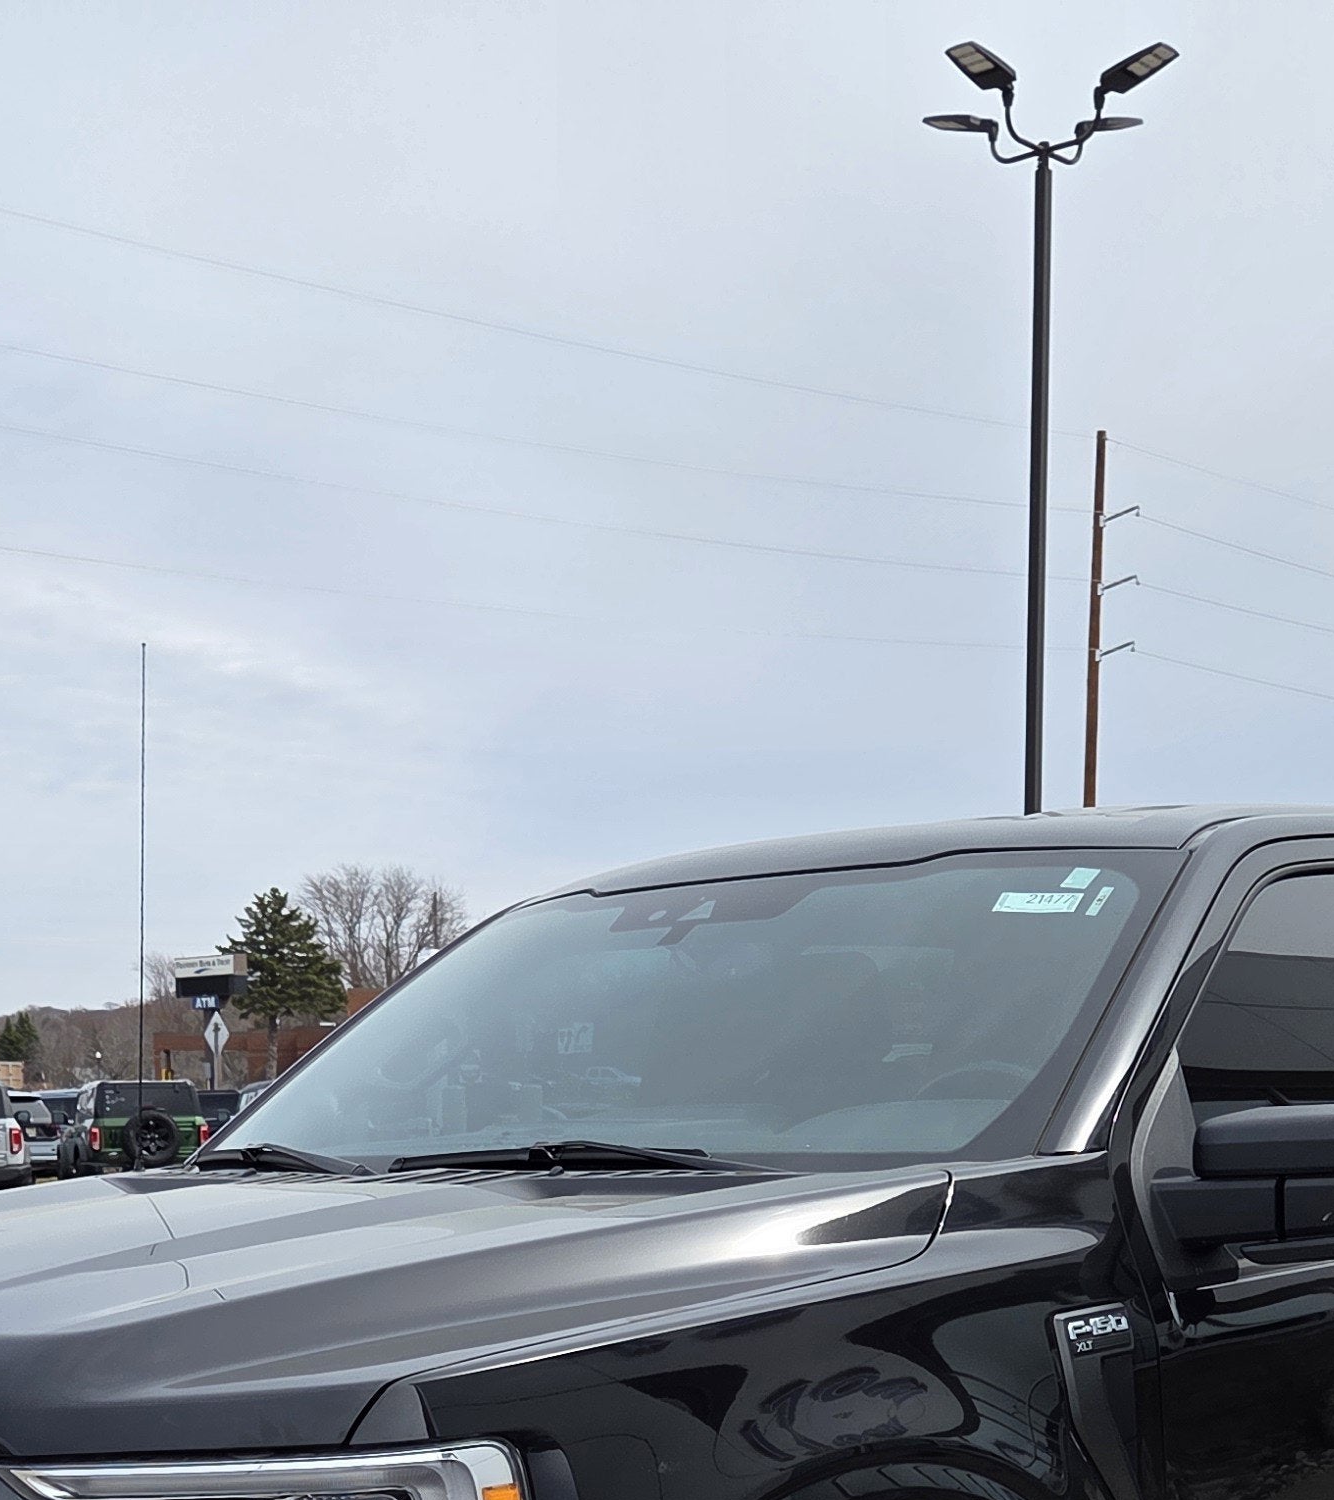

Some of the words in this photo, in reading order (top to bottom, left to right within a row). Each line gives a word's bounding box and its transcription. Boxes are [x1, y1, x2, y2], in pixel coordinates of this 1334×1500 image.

[195, 996, 216, 1009] ATM
[1068, 1314, 1129, 1340] F-150
[1076, 1340, 1094, 1353] XLT
